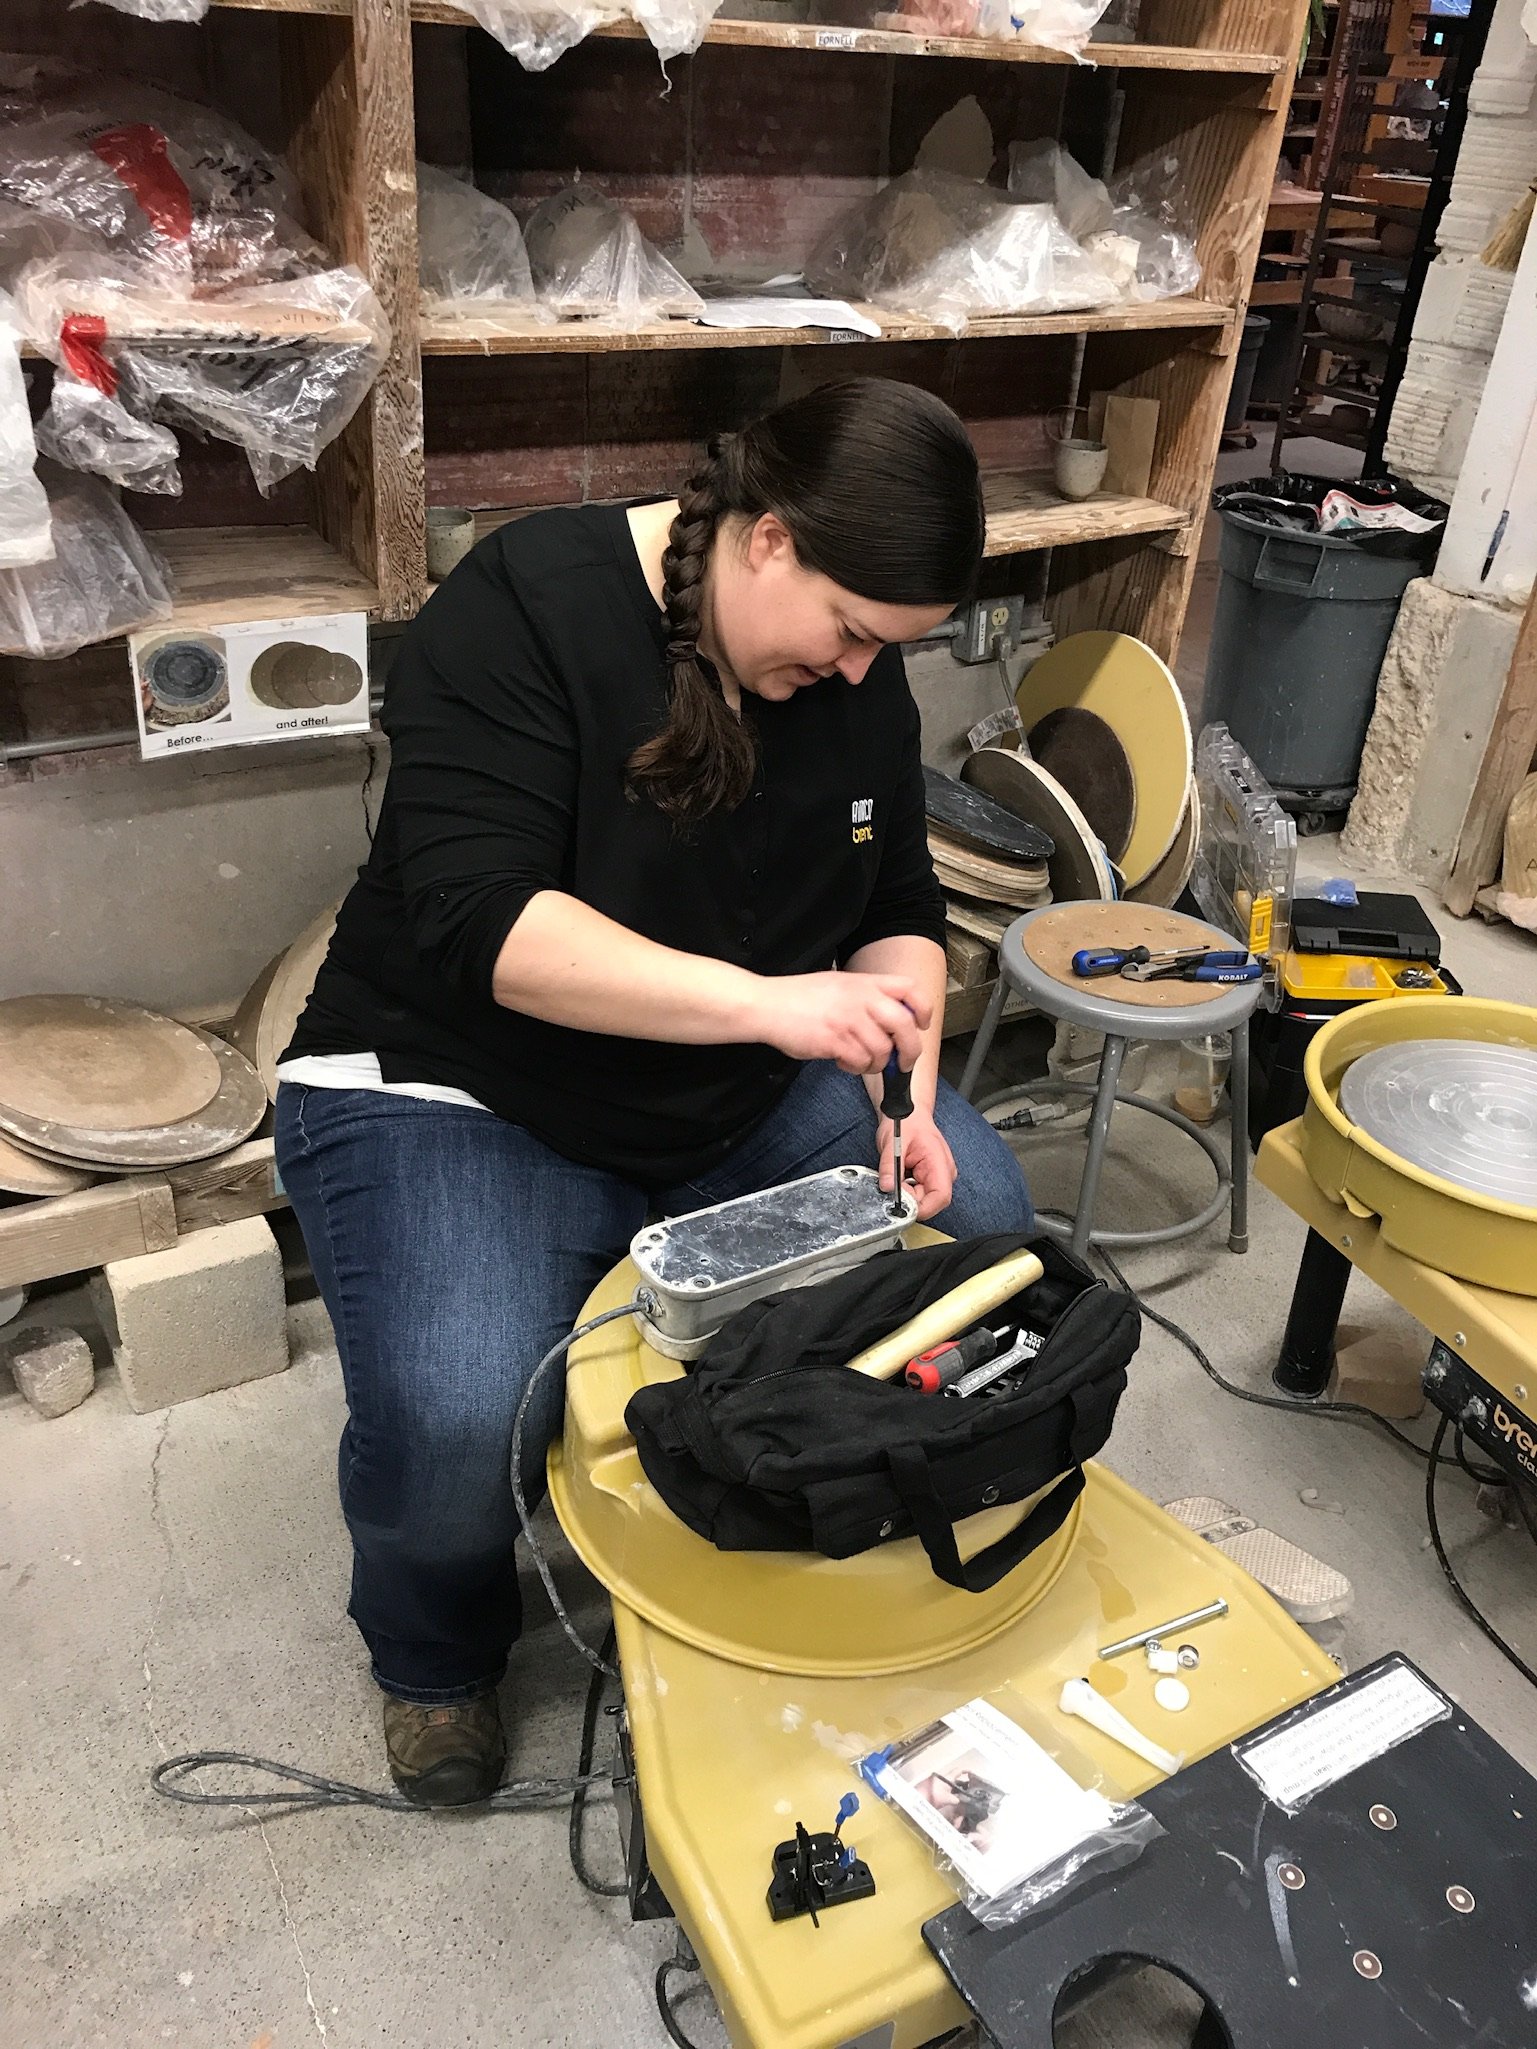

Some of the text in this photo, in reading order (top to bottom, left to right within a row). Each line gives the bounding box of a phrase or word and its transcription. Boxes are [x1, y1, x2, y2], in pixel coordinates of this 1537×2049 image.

[818, 34, 854, 46] FORNELL
[276, 716, 329, 729] and after!
[1218, 973, 1249, 981] KOBALT
